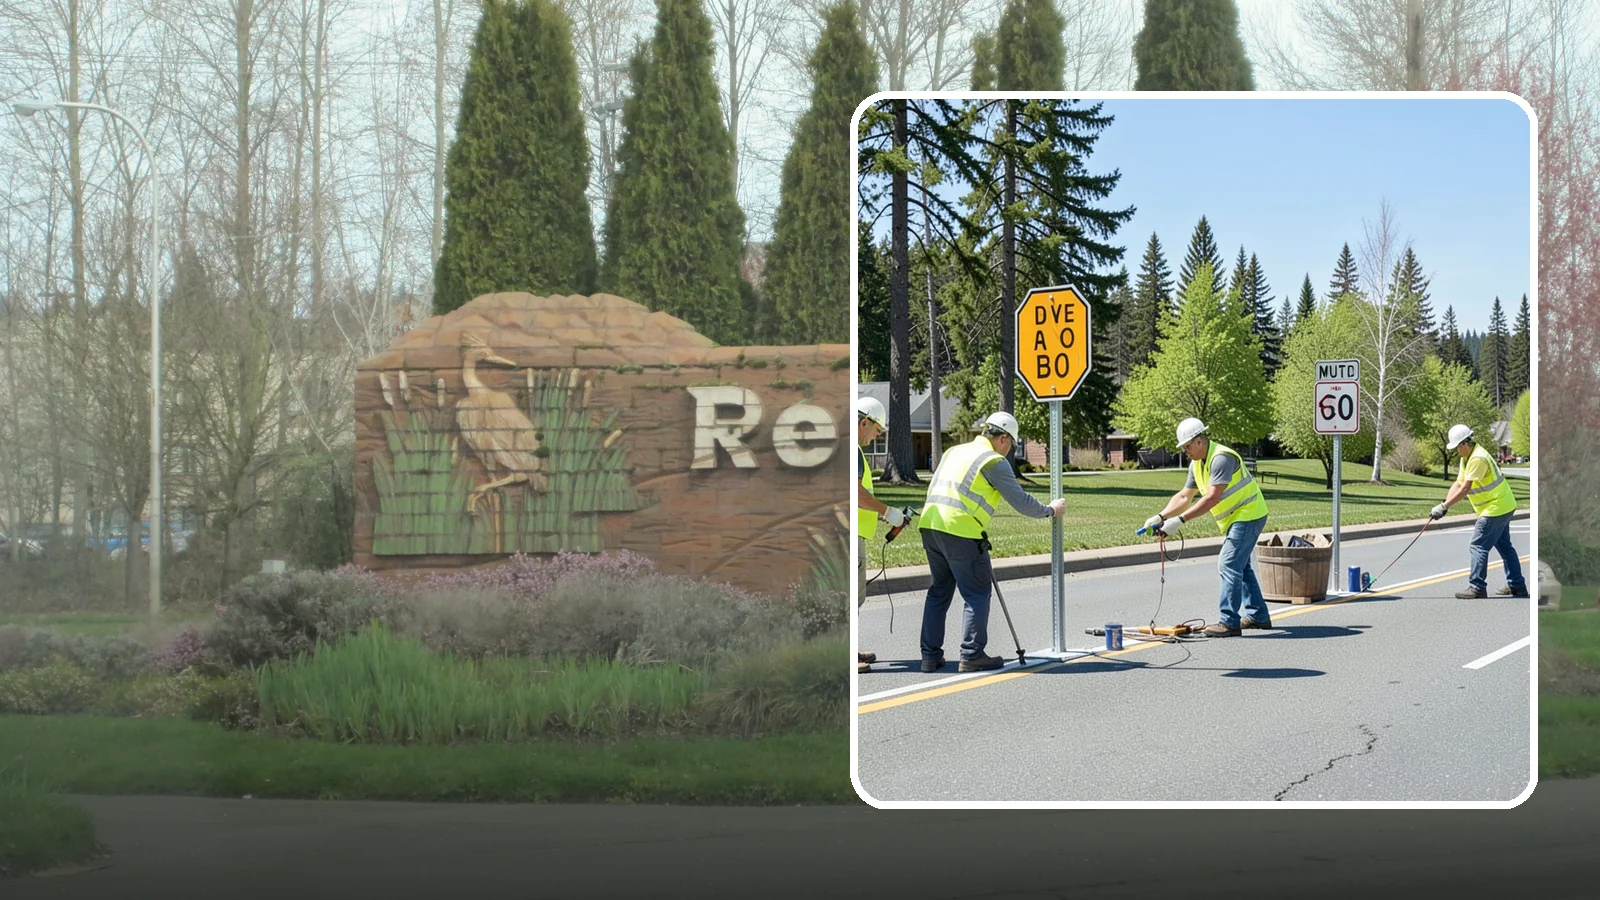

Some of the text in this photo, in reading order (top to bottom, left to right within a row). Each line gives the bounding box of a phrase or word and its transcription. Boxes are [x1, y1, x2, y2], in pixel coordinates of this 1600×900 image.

[1037, 353, 1070, 379] BO
[1319, 394, 1354, 421] 60
[686, 386, 837, 468] Re
